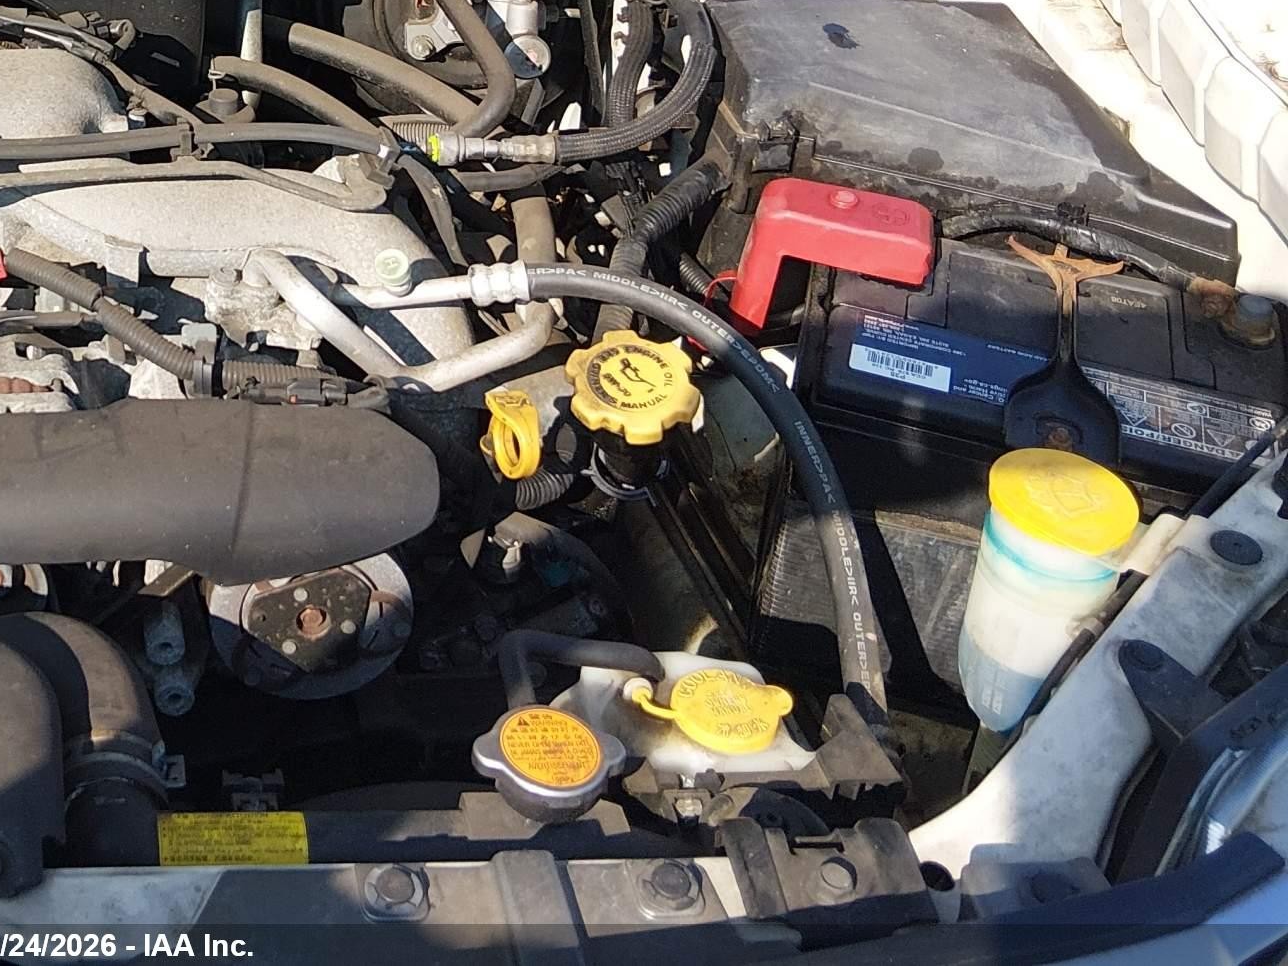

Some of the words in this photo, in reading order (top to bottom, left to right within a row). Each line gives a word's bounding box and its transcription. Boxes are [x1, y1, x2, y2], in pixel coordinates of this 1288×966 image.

[623, 345, 670, 370] ENGINE
[663, 372, 673, 387] OIL
[620, 394, 668, 409] MANUAL
[968, 389, 994, 401] Cancer
